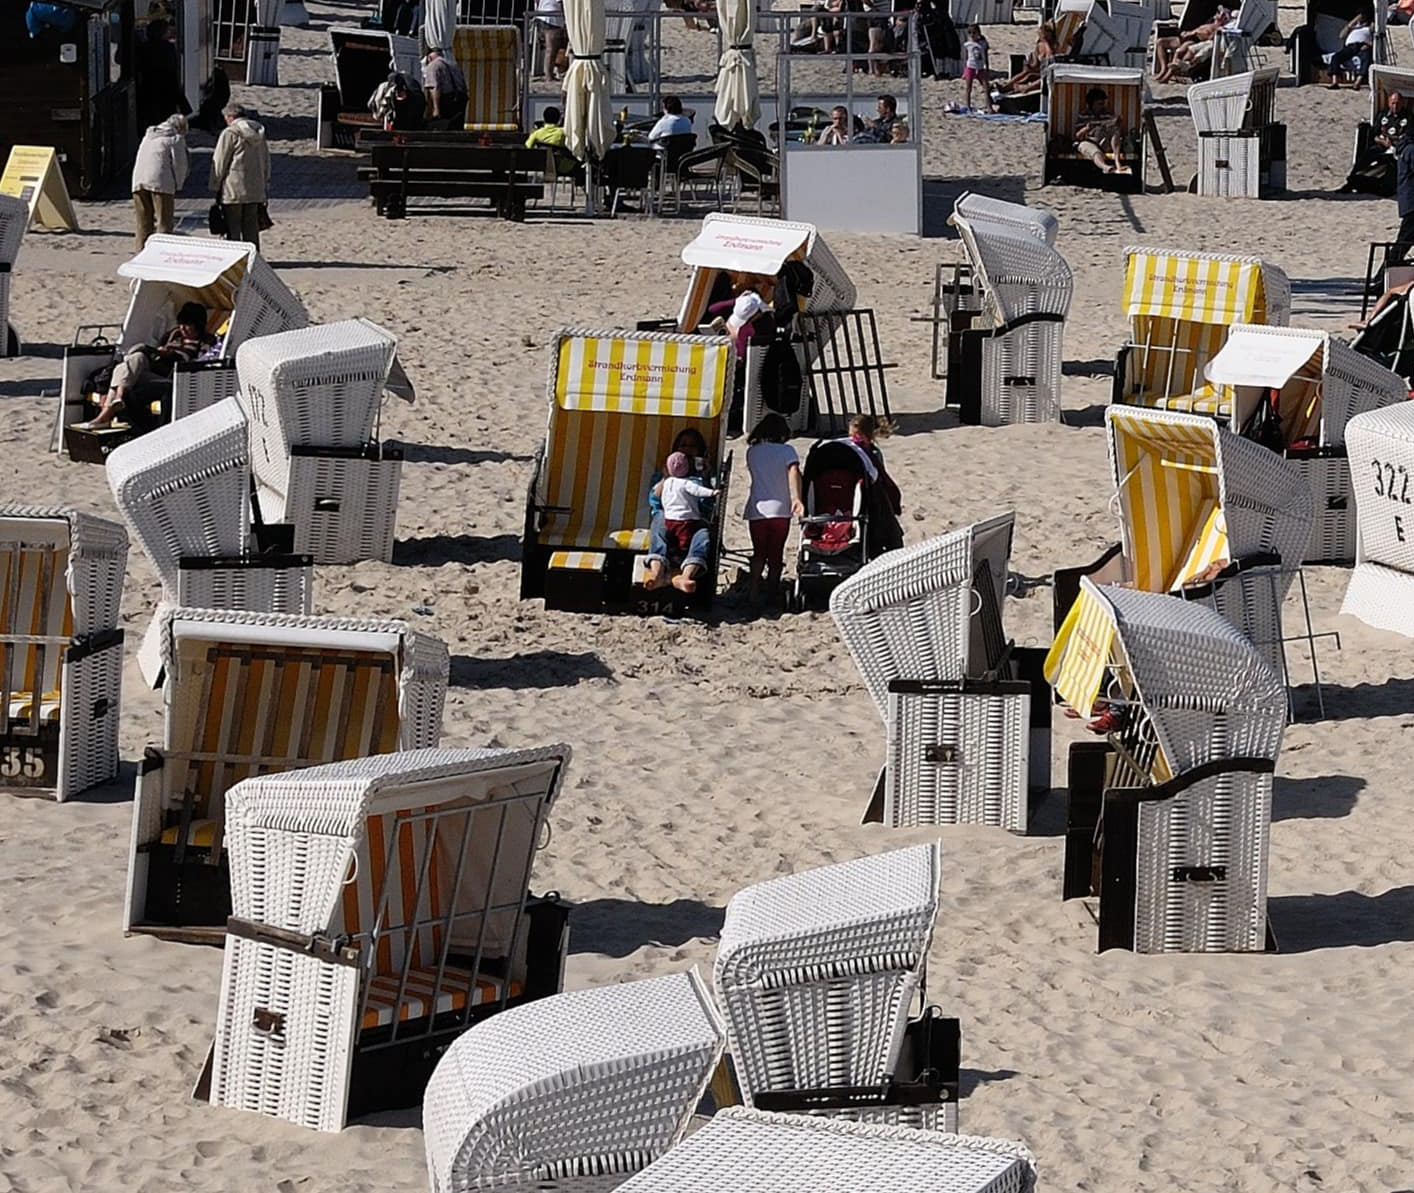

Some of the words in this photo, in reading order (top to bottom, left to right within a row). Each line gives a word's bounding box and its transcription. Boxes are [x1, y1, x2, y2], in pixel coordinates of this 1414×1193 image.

[619, 373, 664, 383] Erdmann
[1371, 459, 1411, 504] 322
[1394, 515, 1406, 542] E
[638, 600, 673, 614] 314
